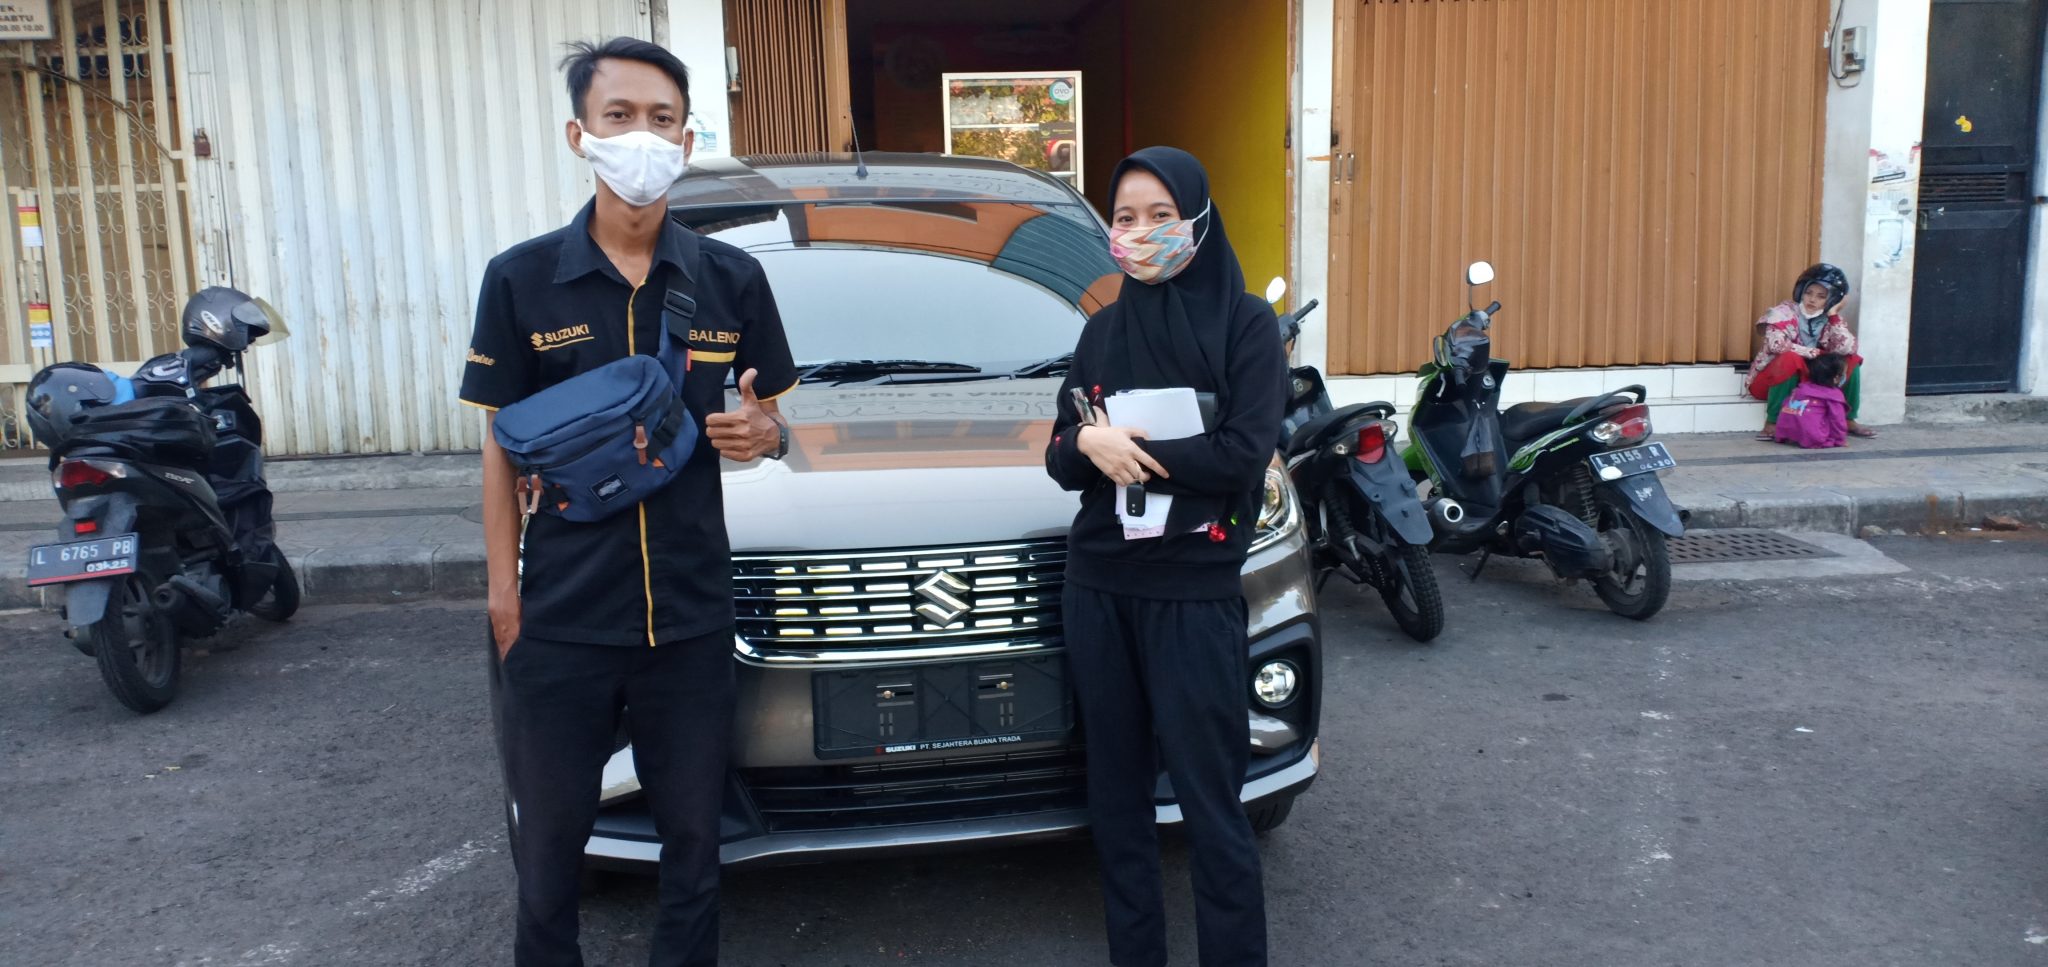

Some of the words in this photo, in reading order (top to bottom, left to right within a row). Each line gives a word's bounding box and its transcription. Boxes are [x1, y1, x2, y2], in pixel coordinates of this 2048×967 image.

[545, 324, 590, 343] SUZUKI
[689, 329, 740, 344] BALENO
[36, 550, 46, 565] L
[61, 544, 99, 561] 6765
[112, 540, 131, 556] PB
[885, 744, 916, 753] SUZUKI
[932, 739, 973, 749] SEJAHTERA
[973, 737, 998, 746] BUANA
[998, 735, 1021, 743] TRADA
